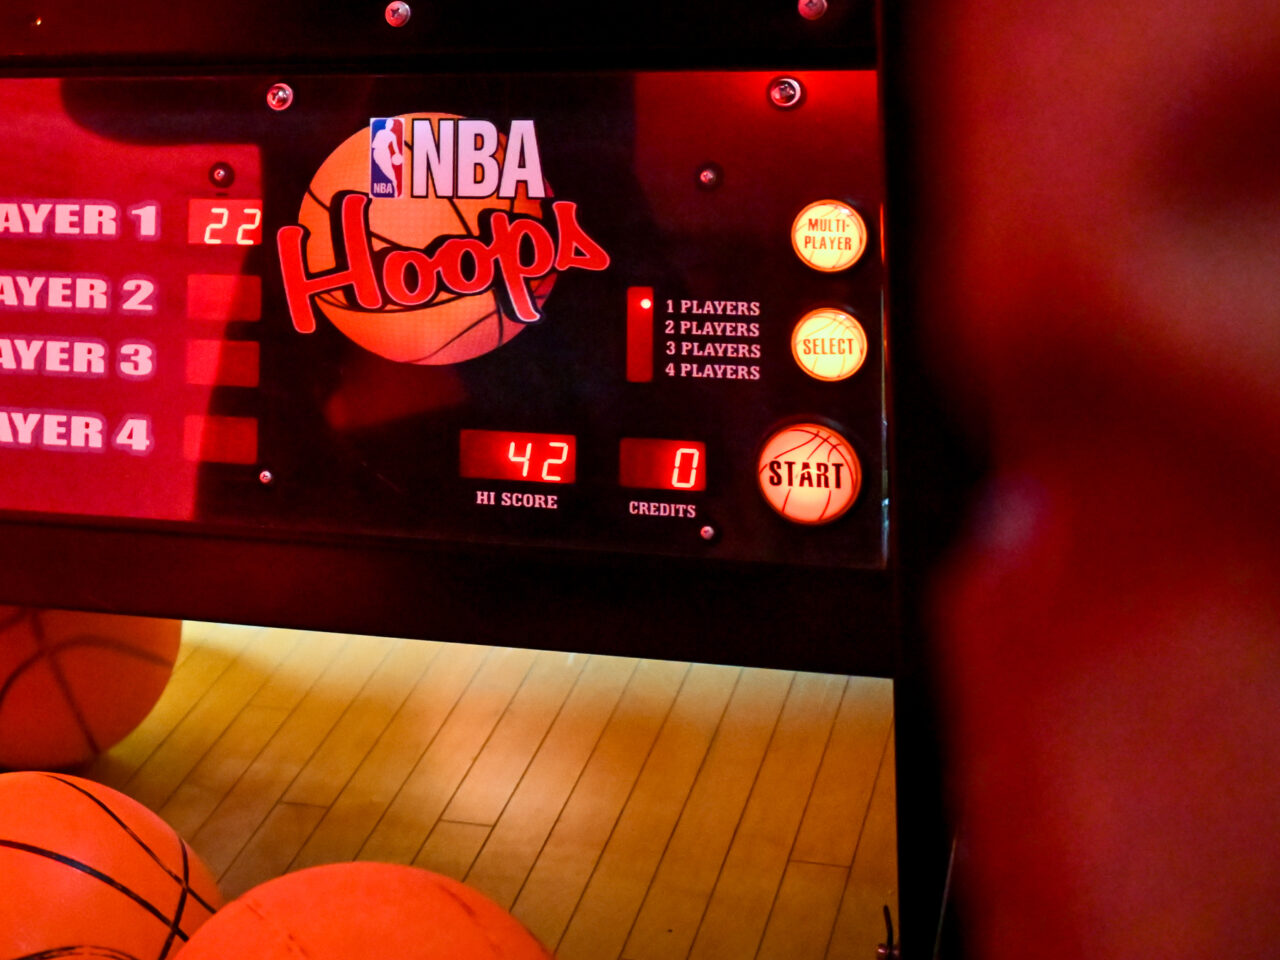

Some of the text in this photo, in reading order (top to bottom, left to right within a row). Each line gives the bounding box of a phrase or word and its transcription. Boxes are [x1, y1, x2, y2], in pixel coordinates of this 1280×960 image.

[412, 119, 546, 199] NBA
[373, 182, 393, 194] NBA
[131, 205, 156, 236] 1
[204, 207, 262, 245] 22
[808, 218, 850, 233] MULTI-
[804, 236, 852, 251] PLAYER
[276, 193, 611, 334] Hoops
[122, 279, 154, 311] 2
[666, 299, 761, 316] 1 PLAYERS
[665, 320, 760, 337] 2 PLAYERS
[666, 341, 761, 358] 3 PLAYERS
[803, 338, 854, 356] SELECT
[120, 343, 153, 376] 3
[665, 362, 761, 380] 4 PLAYERS
[116, 418, 150, 451] 4
[508, 441, 569, 481] 42
[672, 448, 699, 488] 0
[769, 460, 844, 489] START
[476, 491, 558, 509] HI SCORE
[629, 501, 696, 518] CREDITS
